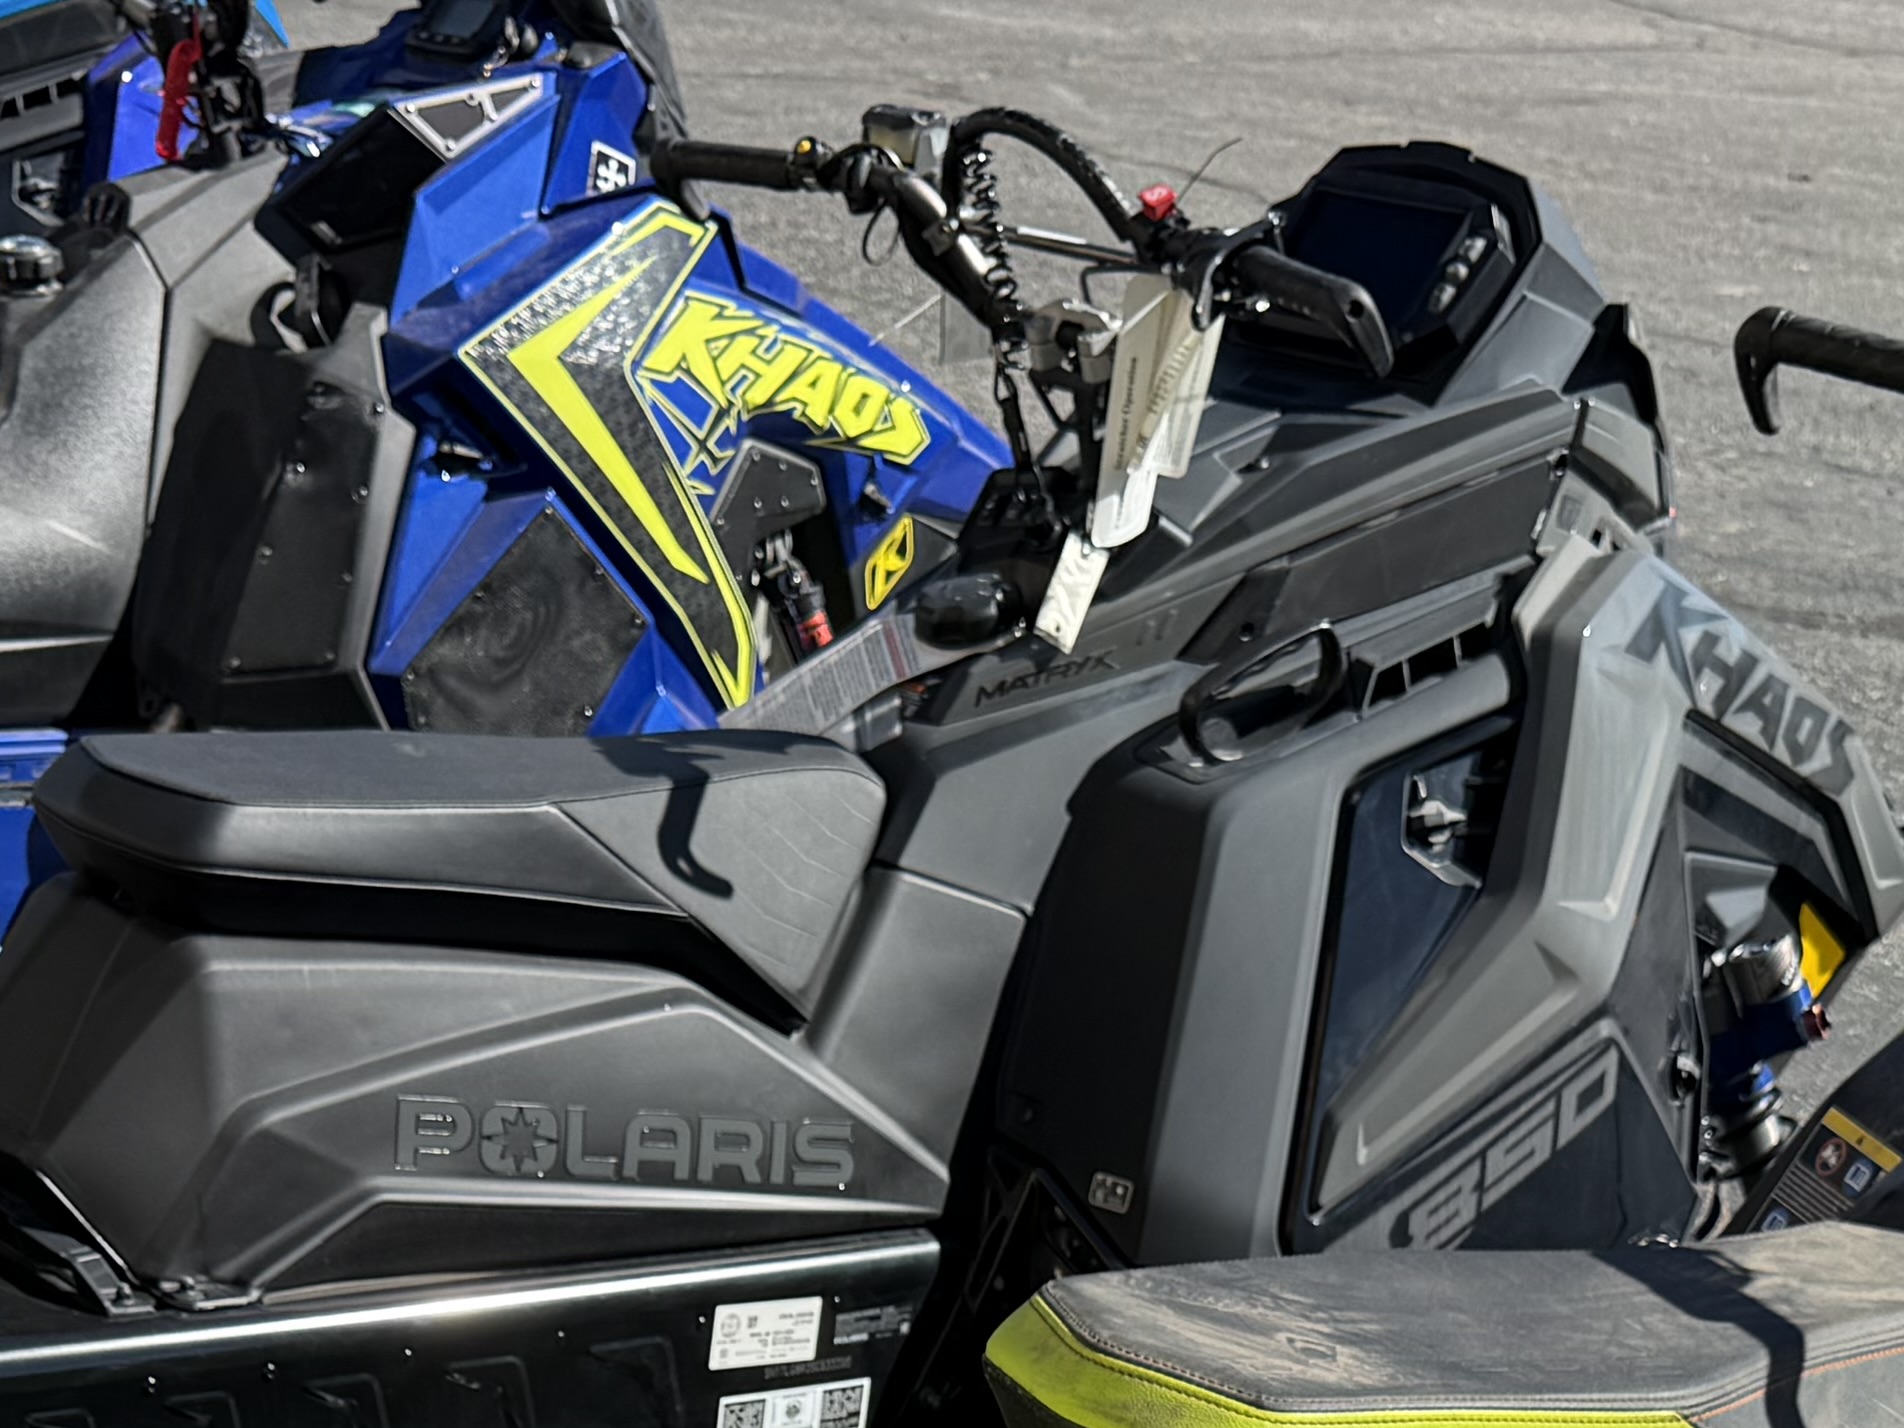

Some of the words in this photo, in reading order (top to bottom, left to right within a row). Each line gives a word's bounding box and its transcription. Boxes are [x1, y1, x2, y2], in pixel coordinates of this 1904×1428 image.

[641, 295, 928, 462] KHAOS
[972, 648, 1122, 708] MATRYX
[1624, 580, 1856, 797] KHAOS
[393, 1093, 856, 1190] POLARIS
[1393, 1040, 1617, 1252] 850
